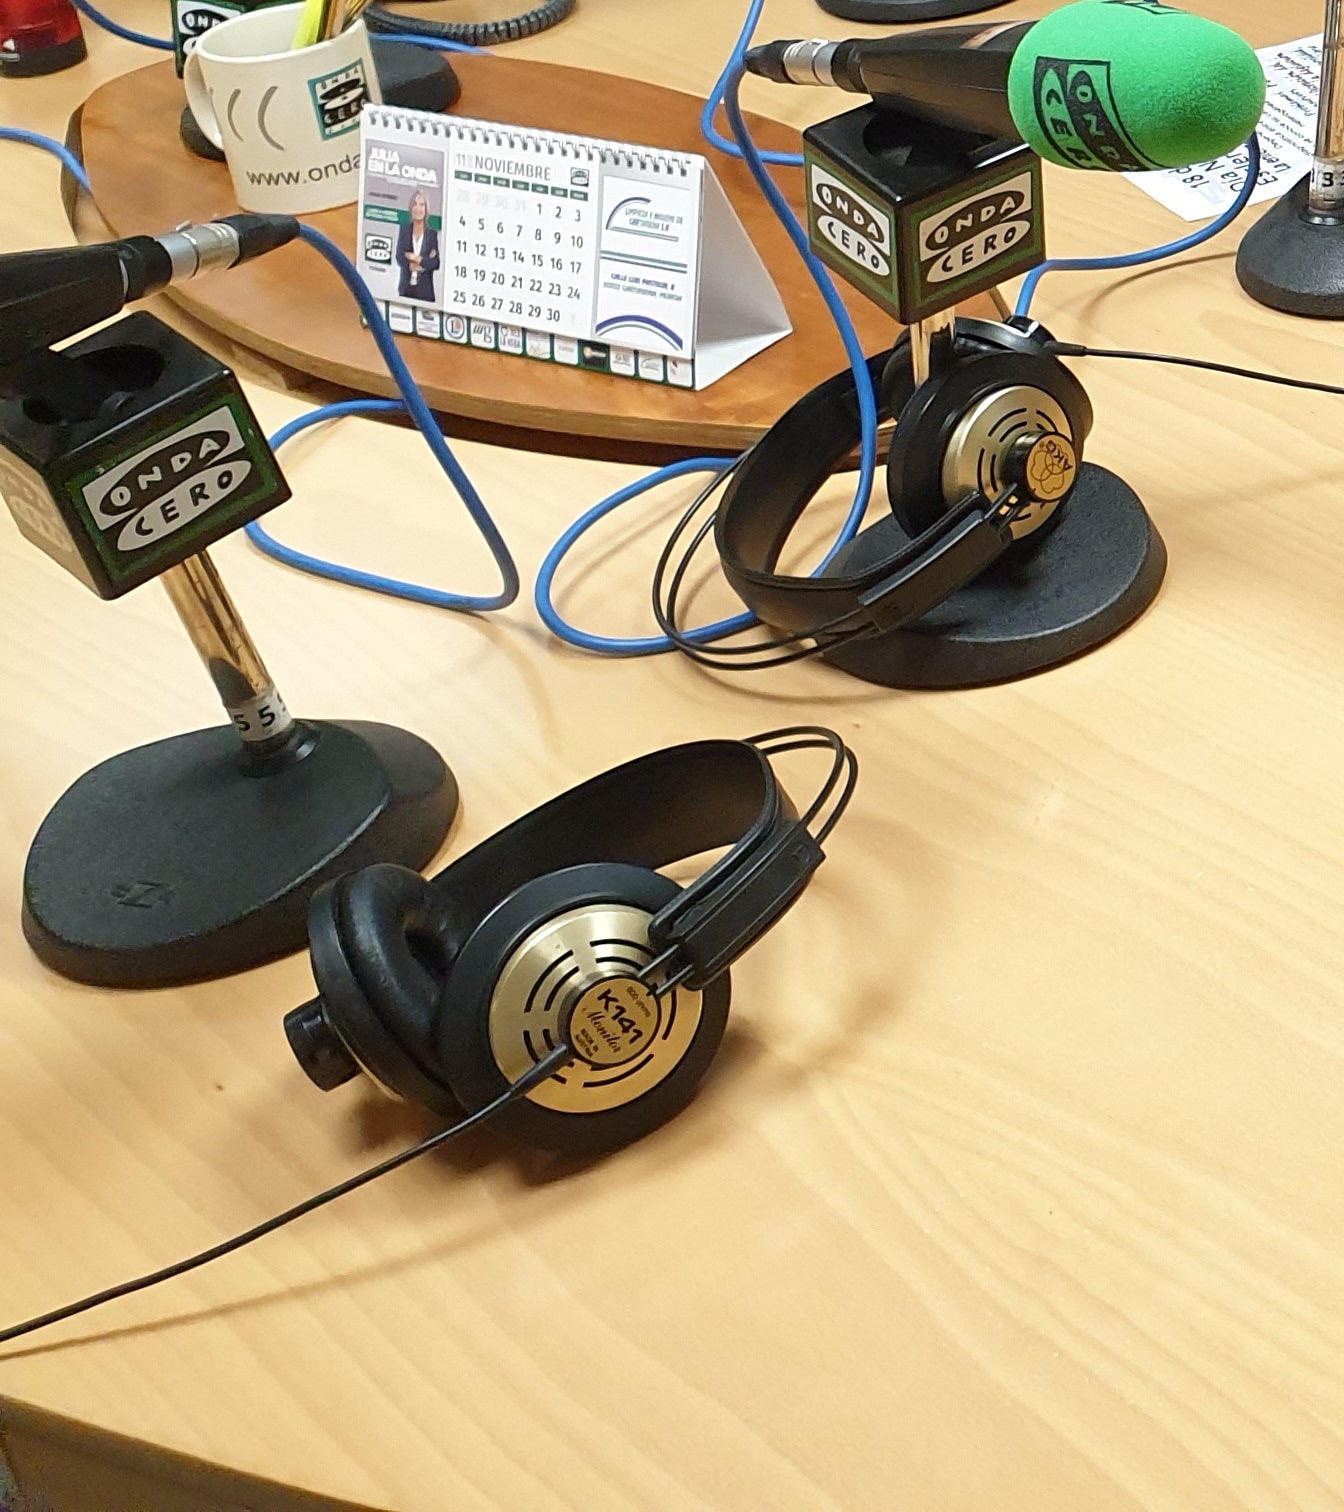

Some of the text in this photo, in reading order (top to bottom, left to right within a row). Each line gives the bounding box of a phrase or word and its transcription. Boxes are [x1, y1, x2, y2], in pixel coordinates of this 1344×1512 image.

[385, 162, 401, 177] LA
[402, 165, 437, 183] ONDA
[474, 155, 551, 181] NOVIEMBRE
[1182, 175, 1210, 188] 18
[1322, 172, 1334, 187] 3
[536, 203, 542, 215] 1
[555, 206, 562, 219] 2
[574, 209, 581, 222] 3
[821, 186, 879, 239] ONDA
[934, 196, 1016, 244] ONDA
[459, 215, 583, 248] 4 5 6 7 8 9 10
[827, 221, 880, 270] CERO
[456, 240, 582, 274] 11 12 13 14 15 16 17
[941, 226, 1017, 273] CERO
[454, 265, 580, 300] 18 19 20 21 22 23 24
[453, 290, 560, 322] 25 26 27 28 29 30
[110, 437, 221, 507] ONDA
[1046, 439, 1074, 471] AKG
[135, 470, 233, 536] CERO
[233, 704, 276, 732] 5 5
[583, 1007, 621, 1053] Monitor
[597, 988, 644, 1044] K141
